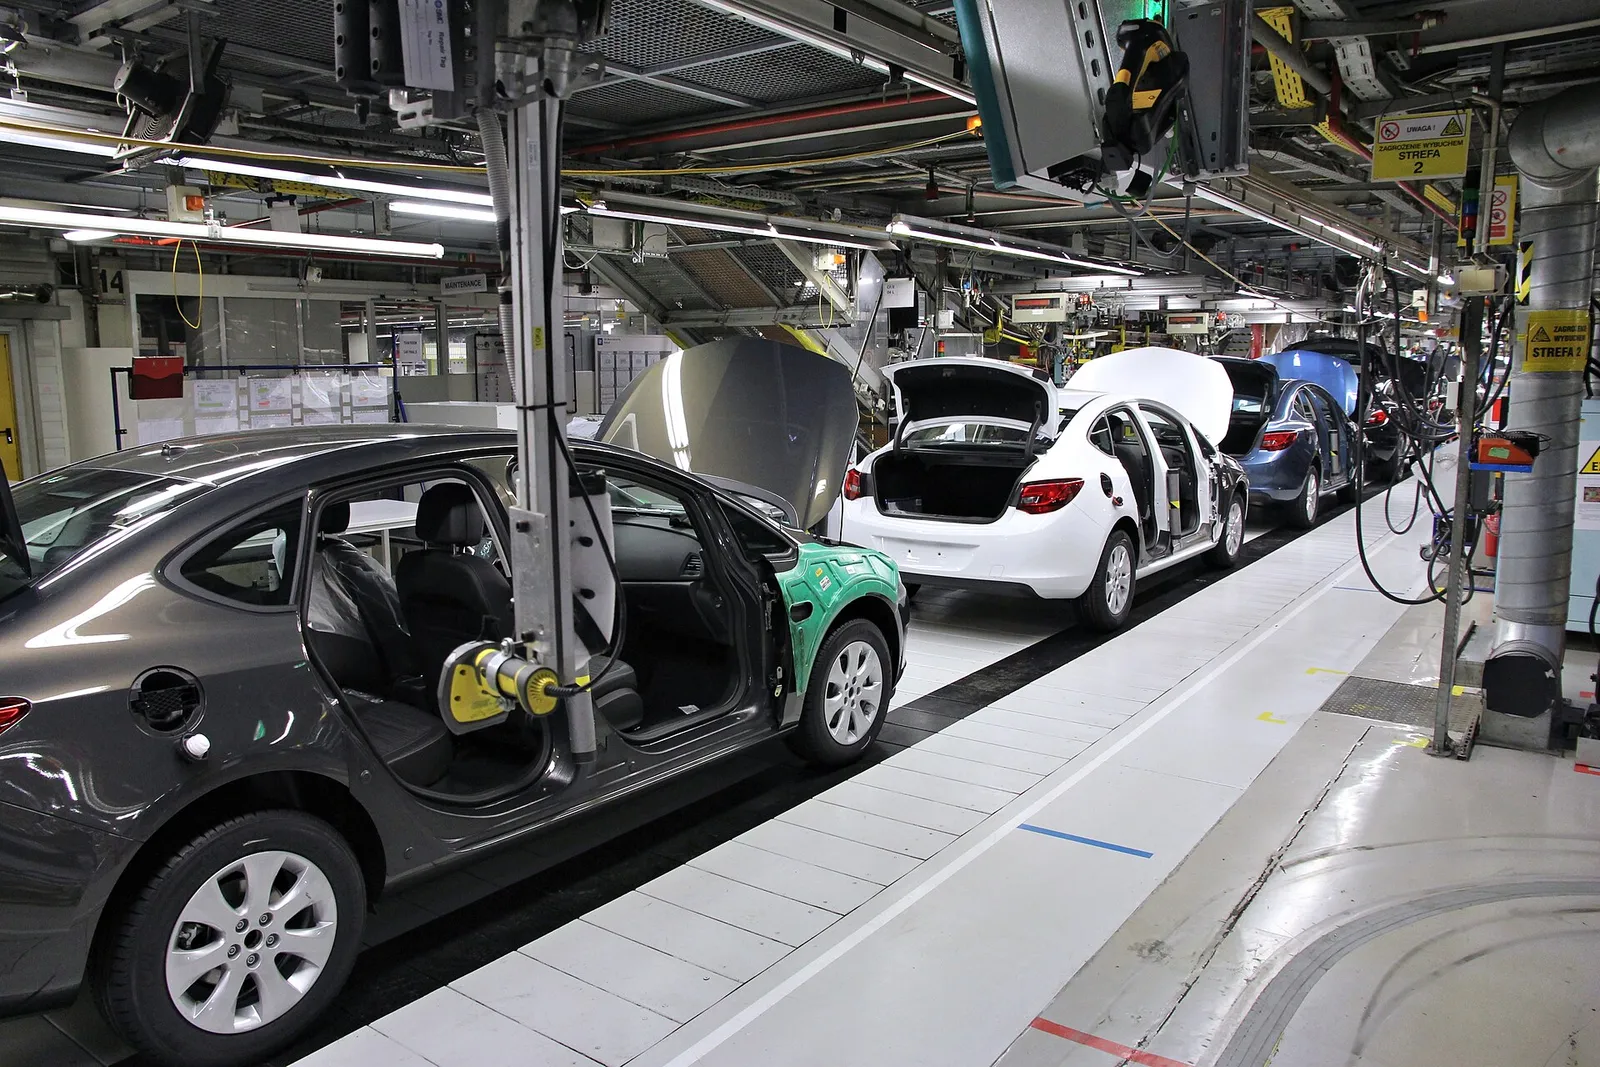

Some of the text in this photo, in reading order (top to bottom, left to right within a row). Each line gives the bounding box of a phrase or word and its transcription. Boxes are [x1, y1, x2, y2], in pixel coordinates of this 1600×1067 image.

[1407, 125, 1432, 133] UWAGA
[1423, 140, 1464, 148] WYBUCHEM
[1399, 150, 1440, 160] STREFA
[1414, 162, 1423, 173] 2
[100, 269, 124, 293] 14
[444, 279, 482, 289] MAINTENANCE
[1533, 347, 1582, 357] STREFA 2
